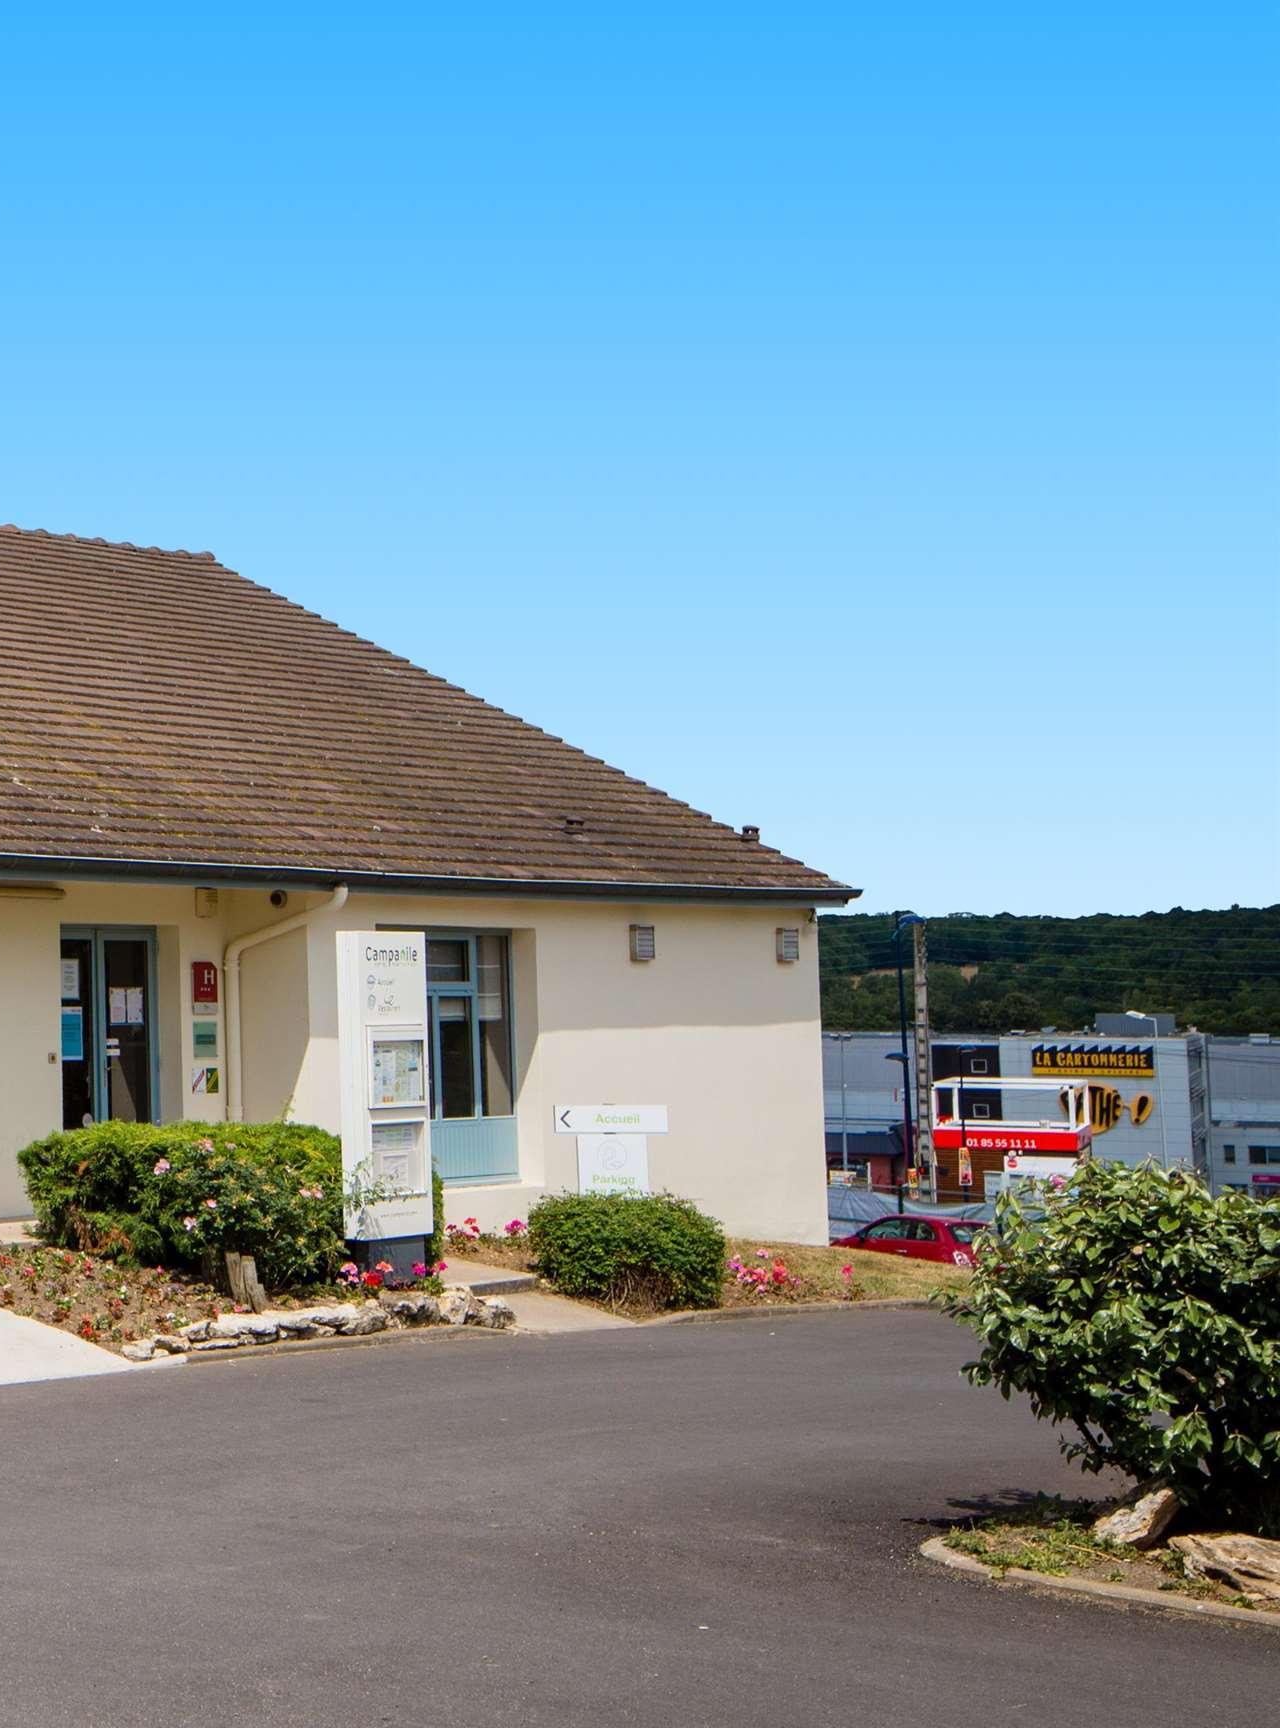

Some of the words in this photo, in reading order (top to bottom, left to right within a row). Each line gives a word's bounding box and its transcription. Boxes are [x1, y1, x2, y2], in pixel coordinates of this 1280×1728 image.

[365, 946, 418, 967] Campanile
[204, 969, 215, 985] H
[1035, 1051, 1052, 1066] LA
[1056, 1052, 1148, 1067] CARTONNERIE
[594, 1113, 641, 1125] Accueil
[966, 1138, 979, 1147] 01
[980, 1138, 994, 1148] 85
[995, 1138, 1008, 1148] 55
[1009, 1138, 1022, 1149] 11
[1023, 1139, 1037, 1149] 11
